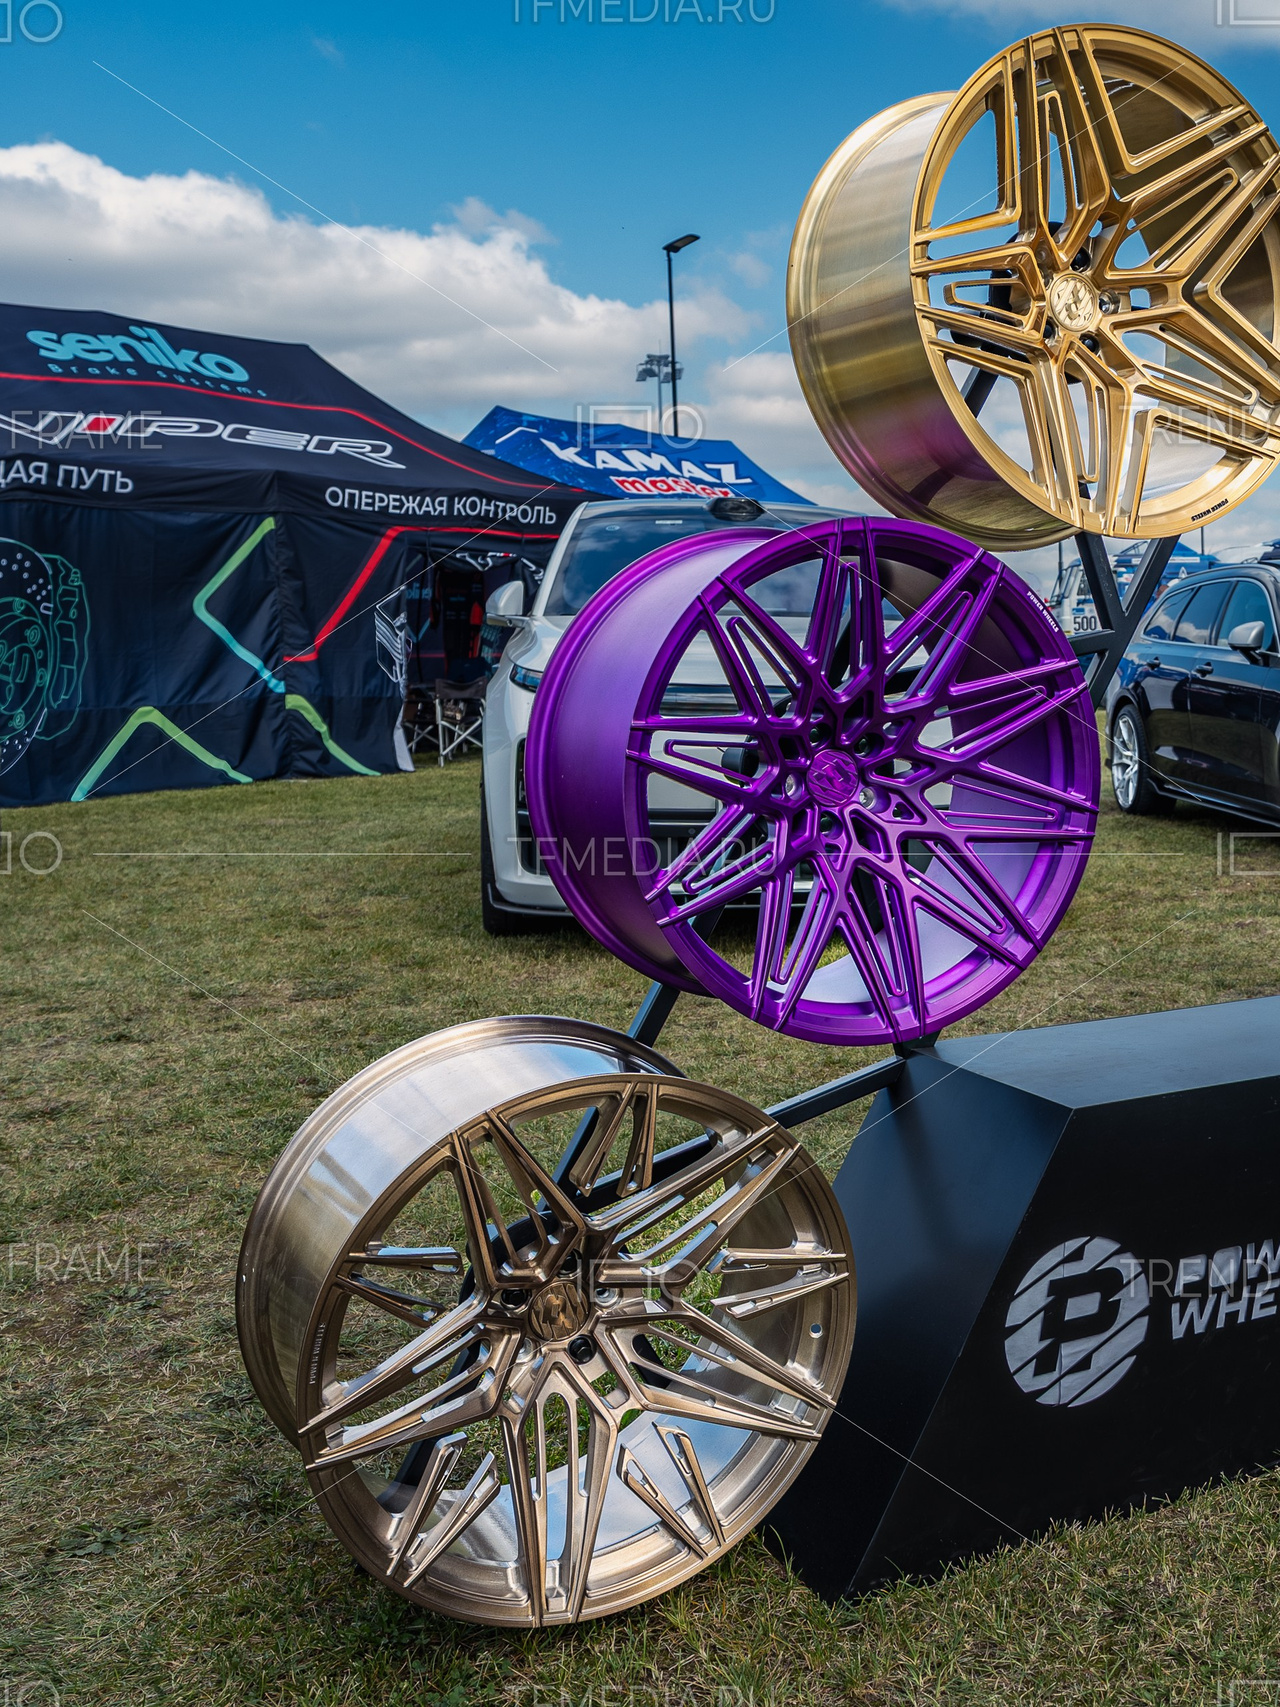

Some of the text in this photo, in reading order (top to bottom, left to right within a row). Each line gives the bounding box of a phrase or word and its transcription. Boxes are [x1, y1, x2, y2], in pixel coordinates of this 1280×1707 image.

[26, 325, 249, 383] seniko
[47, 363, 267, 397] Brake systems
[540, 437, 752, 484] KAMAZ
[57, 464, 135, 494] ПУТЬ
[325, 486, 557, 525] ОПЕРЕЖАЯ КОНТРОЛЬ
[1073, 615, 1097, 631] 500
